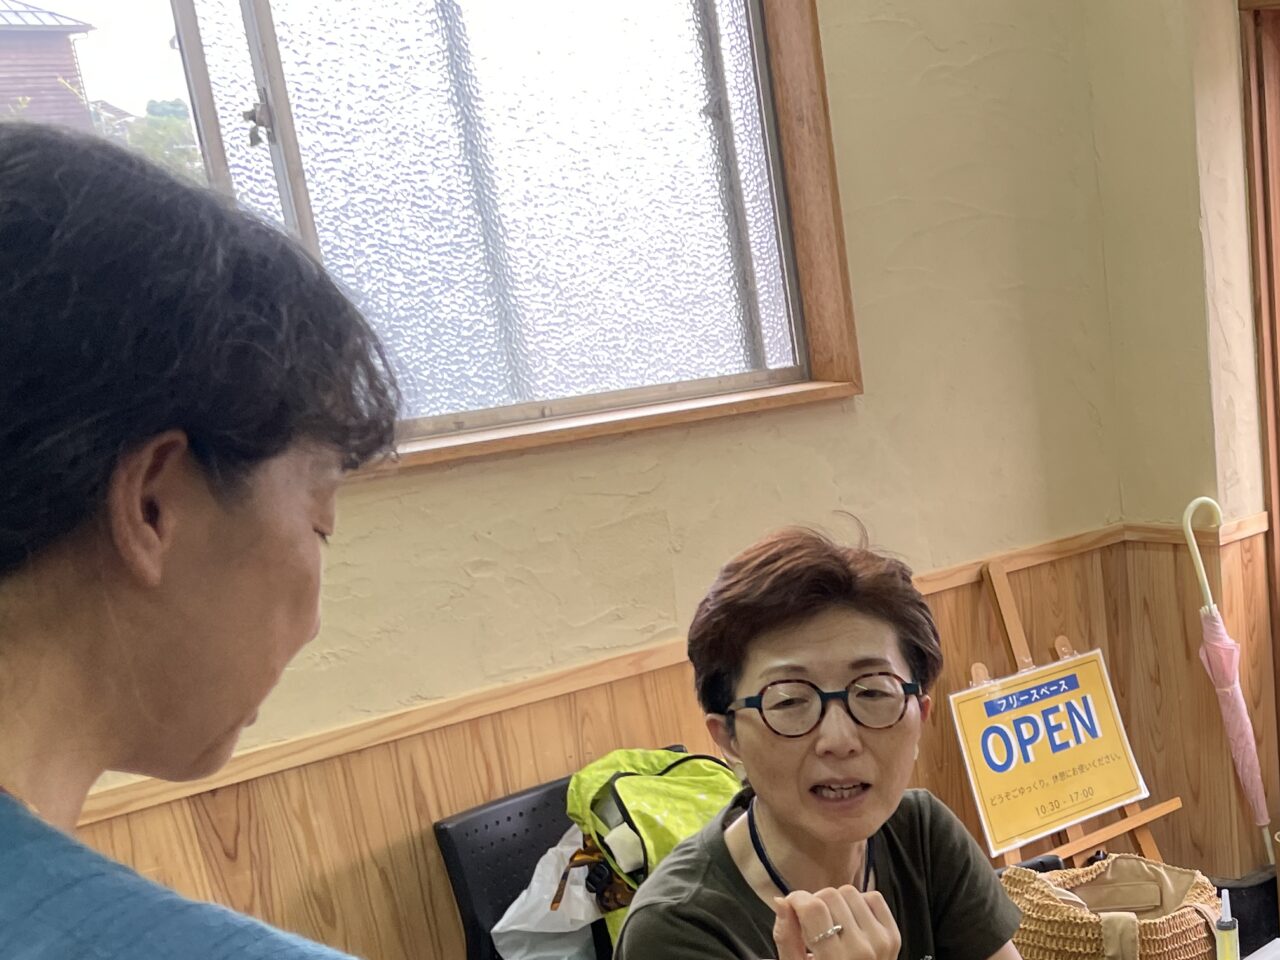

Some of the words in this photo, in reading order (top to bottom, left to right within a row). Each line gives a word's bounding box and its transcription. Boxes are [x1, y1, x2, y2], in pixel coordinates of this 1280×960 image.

[997, 680, 1069, 712] フリースペース
[981, 695, 1101, 774] OPEN
